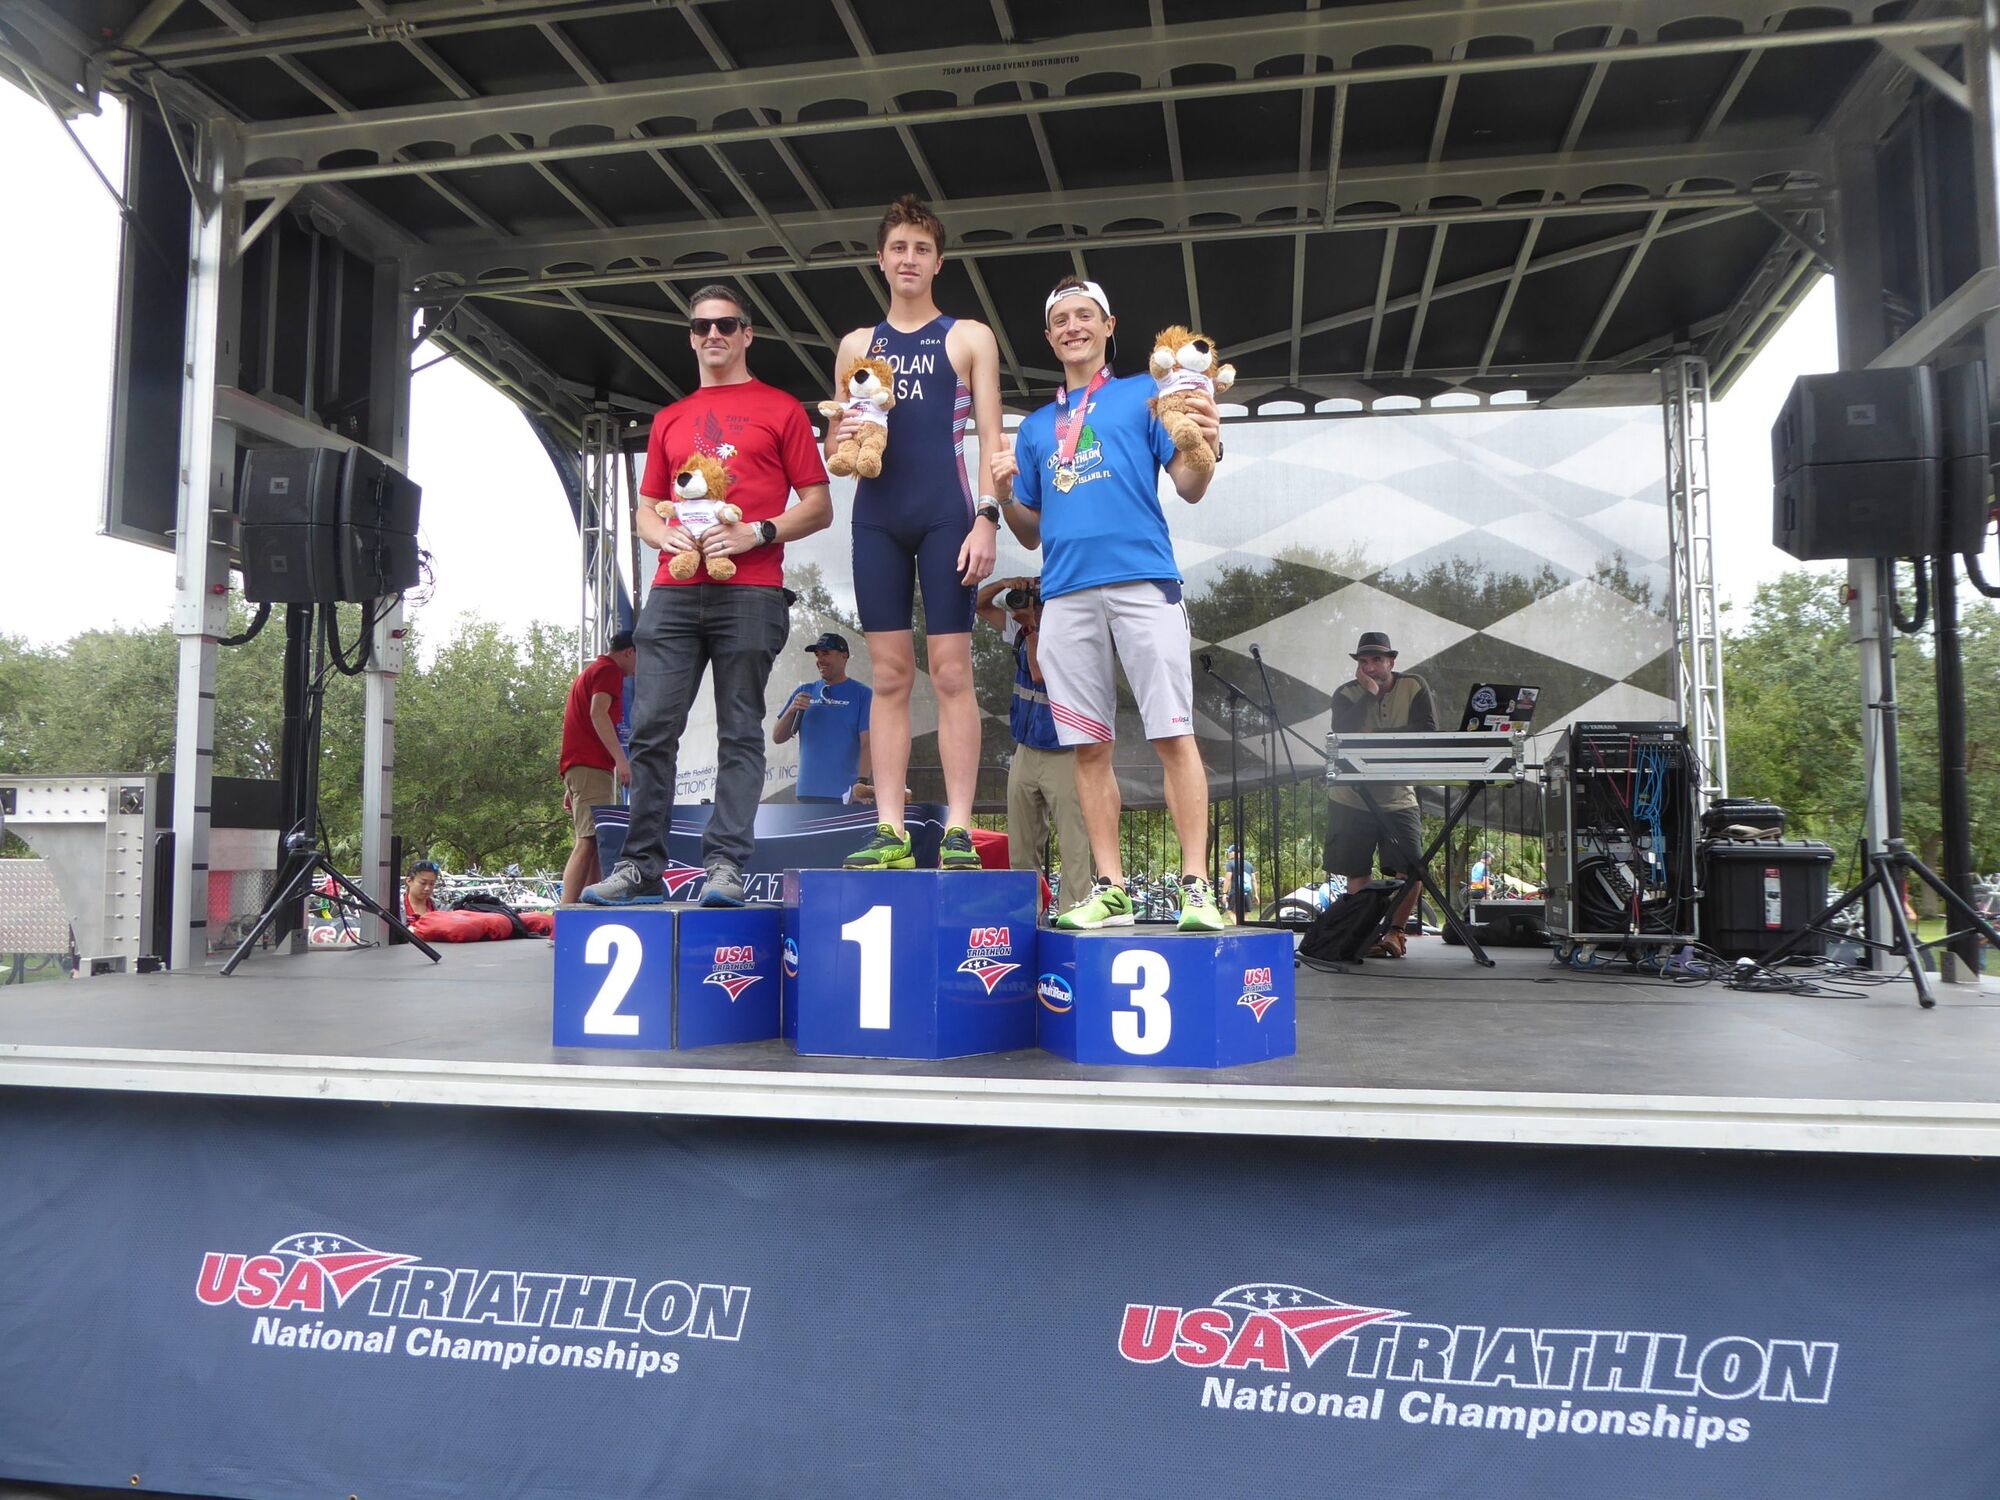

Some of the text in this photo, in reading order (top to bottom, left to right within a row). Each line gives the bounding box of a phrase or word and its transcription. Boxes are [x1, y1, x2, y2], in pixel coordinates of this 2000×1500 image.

[964, 65, 981, 74] MAX
[982, 63, 1001, 73] LOAD
[1003, 61, 1030, 71] EVENLY
[1031, 55, 1080, 68] DISTRIBUTED
[875, 354, 935, 375] OLAN
[892, 379, 924, 400] SA
[675, 778, 708, 796] CTIONS
[968, 927, 1011, 949] USA
[714, 945, 754, 964] USA
[967, 946, 1012, 958] TRIATHLON
[712, 961, 756, 972] TRIATHLON
[841, 905, 892, 1030] 1
[1244, 967, 1272, 986] USA
[583, 924, 643, 1036] 2
[1111, 949, 1172, 1055] 3
[196, 1252, 752, 1342] USA TRIATHLON
[251, 1316, 681, 1379] National Championships
[1118, 1303, 1840, 1404] USA TRIATHLON
[1200, 1376, 1751, 1449] National Championships
